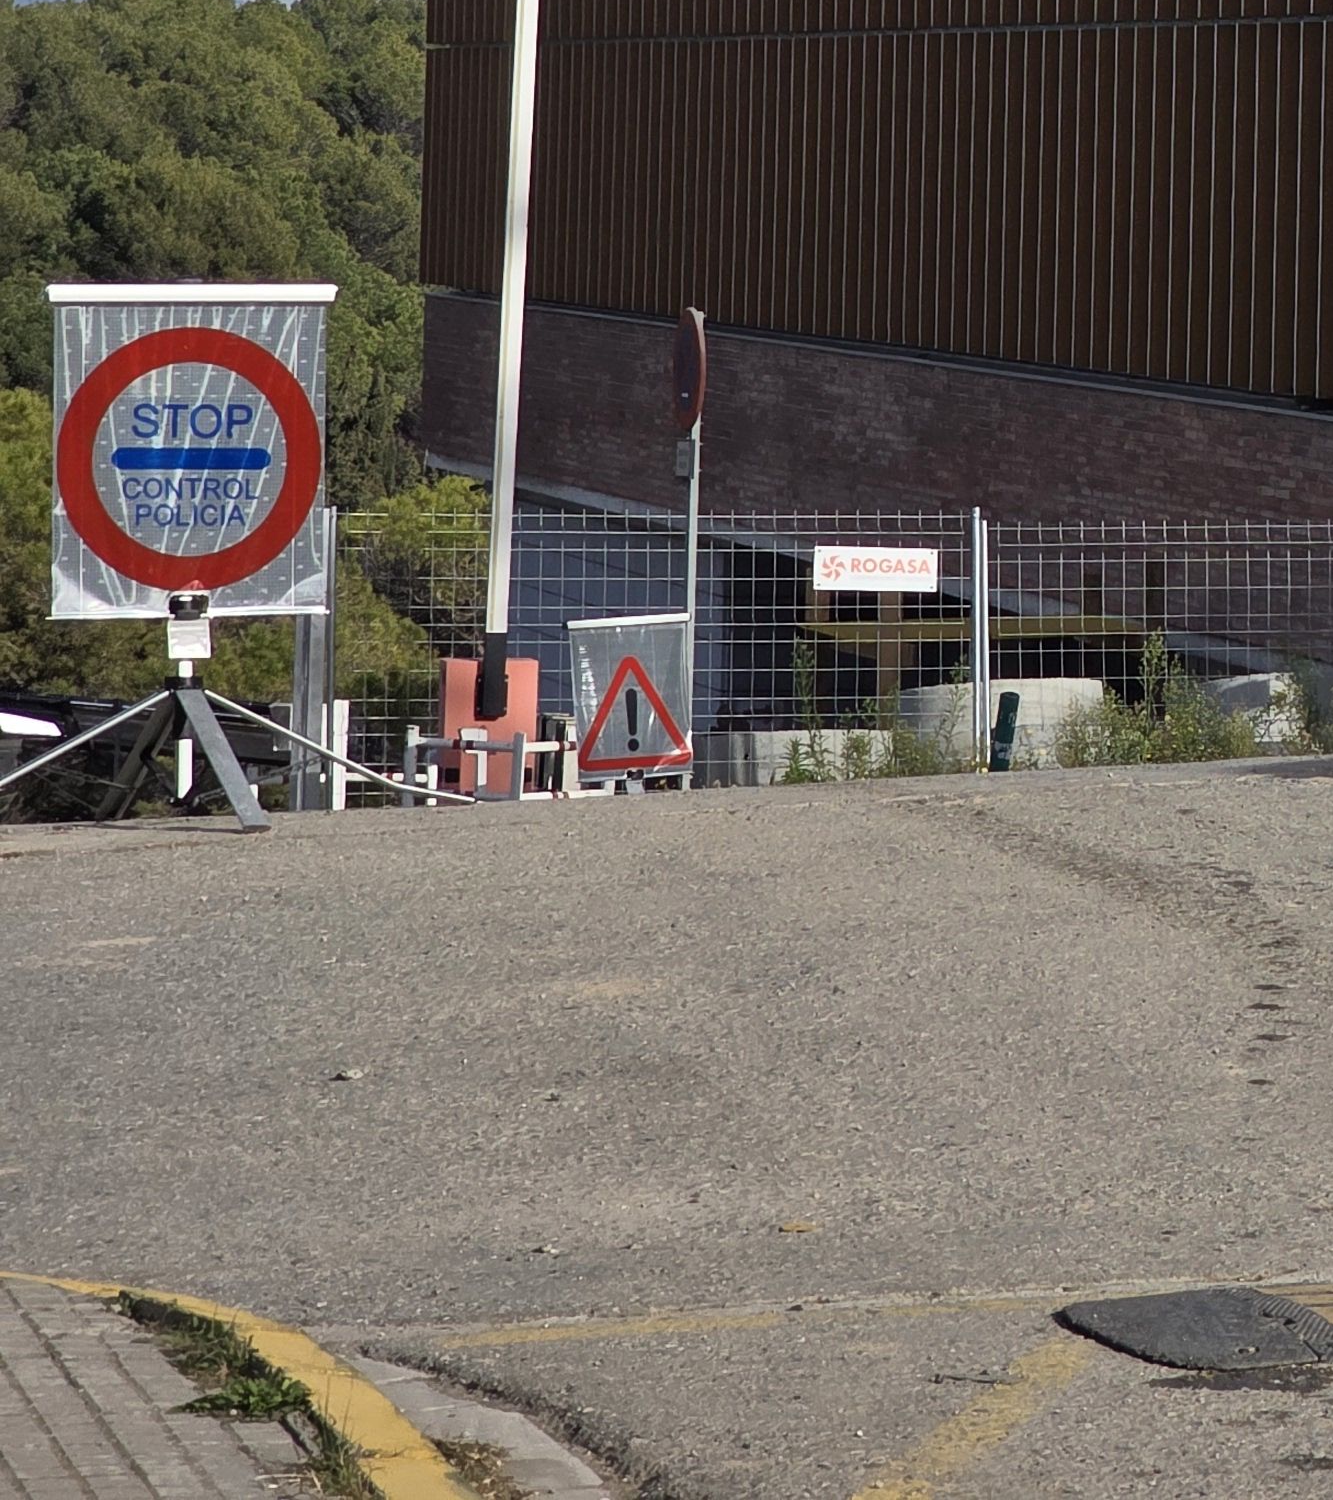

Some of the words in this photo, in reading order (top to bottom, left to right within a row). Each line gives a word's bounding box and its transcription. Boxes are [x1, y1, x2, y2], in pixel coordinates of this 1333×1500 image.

[131, 403, 253, 439] STOP
[122, 477, 259, 501] CONTROL
[134, 503, 246, 527] POLICIA
[850, 558, 931, 574] ROGASA
